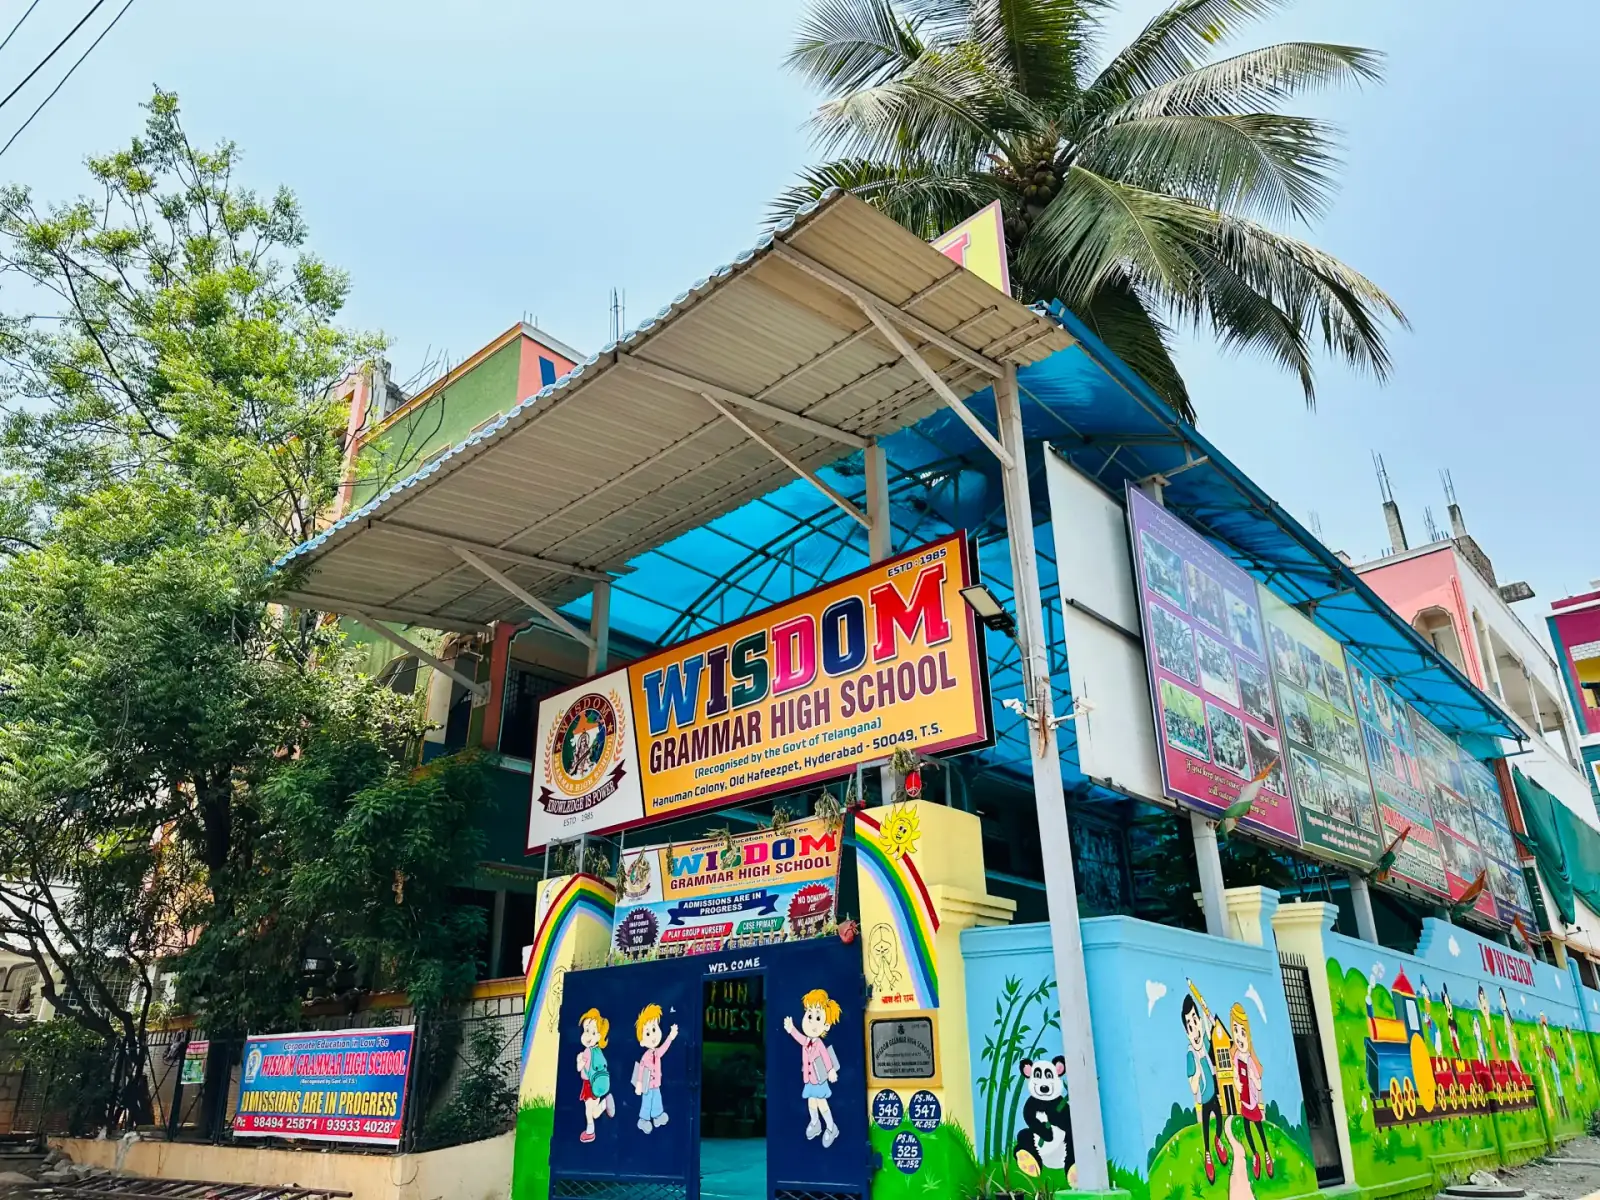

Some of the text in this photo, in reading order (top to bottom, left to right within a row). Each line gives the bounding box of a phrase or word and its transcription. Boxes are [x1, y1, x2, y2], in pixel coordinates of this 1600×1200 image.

[887, 561, 913, 577] ESTD
[919, 548, 947, 565] 1985
[642, 561, 952, 737] WISDOM
[560, 697, 611, 733] WISDOM
[650, 650, 957, 775] GRAMMAR HIGH SCHOOL
[694, 717, 882, 779] (Recognised by the Govt of Telangana)
[652, 789, 693, 808] Hanuman
[694, 780, 728, 797] Colony,
[729, 774, 745, 787] Old
[747, 760, 802, 784] Hafeezpet,
[804, 741, 864, 768] Hyderabad
[872, 728, 918, 750] 50049,
[920, 722, 943, 738] T.S.
[546, 781, 616, 814] KNOWLEDGE IS POWER
[575, 778, 593, 791] HIGH
[563, 816, 576, 827] ESTD
[690, 841, 725, 852] Corporate
[727, 834, 764, 846] ducation
[794, 826, 808, 834] Fee
[669, 830, 837, 877] WISDOM
[670, 871, 734, 890] GRAMMAR
[738, 864, 771, 880] HIGH
[775, 856, 832, 874] SCHOOL
[683, 891, 762, 909] ADMISSIONS ARE IN
[700, 903, 743, 915] PROGRESS
[797, 896, 806, 904] NO
[667, 924, 726, 938] PLAY GROUP NURSERY
[1493, 947, 1536, 988] WISDOM
[283, 1042, 315, 1053] Corporate
[316, 1039, 350, 1049] Education
[360, 1037, 375, 1048] Low
[376, 1036, 390, 1048] Fee
[260, 1049, 406, 1077] WISDOM GRAMMAR HIGH SCHOOL
[241, 1090, 398, 1117] DMISSIONS ARE IN PROGRESS
[878, 1103, 900, 1117] 346
[914, 1104, 936, 1118] 347
[253, 1116, 284, 1128] 98494
[286, 1118, 318, 1130] 25871
[326, 1119, 360, 1132] 93933
[363, 1120, 397, 1134] 40287
[897, 1145, 918, 1158] 325
